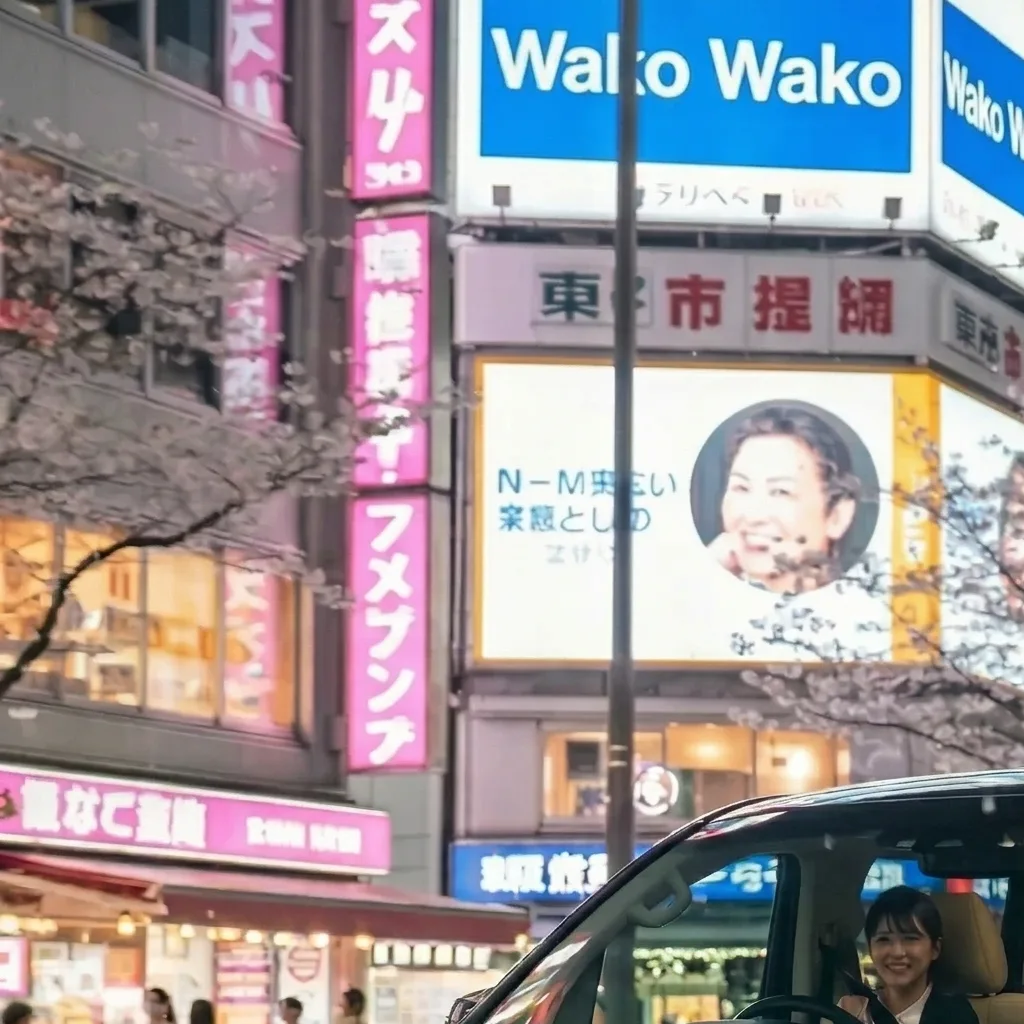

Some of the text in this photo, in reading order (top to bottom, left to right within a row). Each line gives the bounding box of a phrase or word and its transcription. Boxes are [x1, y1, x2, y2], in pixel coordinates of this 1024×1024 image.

[490, 27, 902, 108] Wako Wako
[943, 49, 1005, 143] Wako
